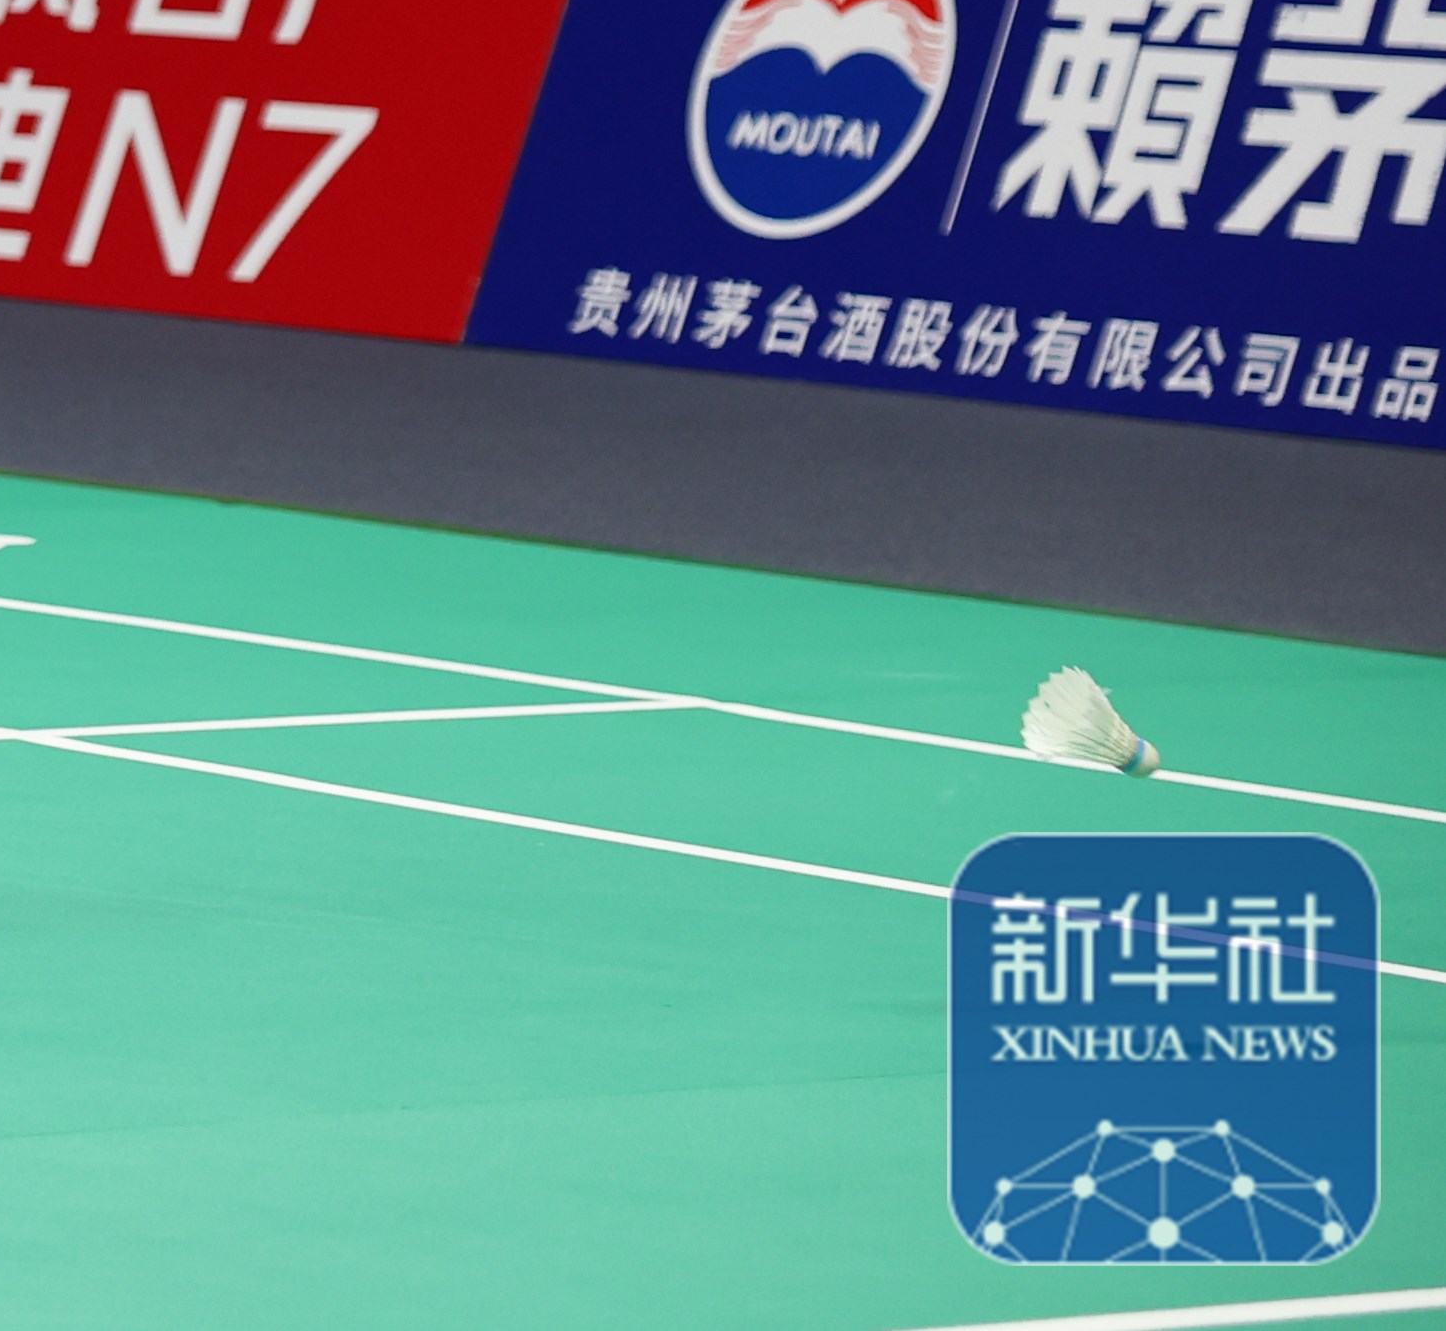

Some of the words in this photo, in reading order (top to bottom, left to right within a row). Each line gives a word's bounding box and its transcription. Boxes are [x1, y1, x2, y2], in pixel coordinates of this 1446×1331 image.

[726, 110, 881, 161] MOUTAI
[567, 266, 1442, 425] 贵州茅台酒股份有限公司出品
